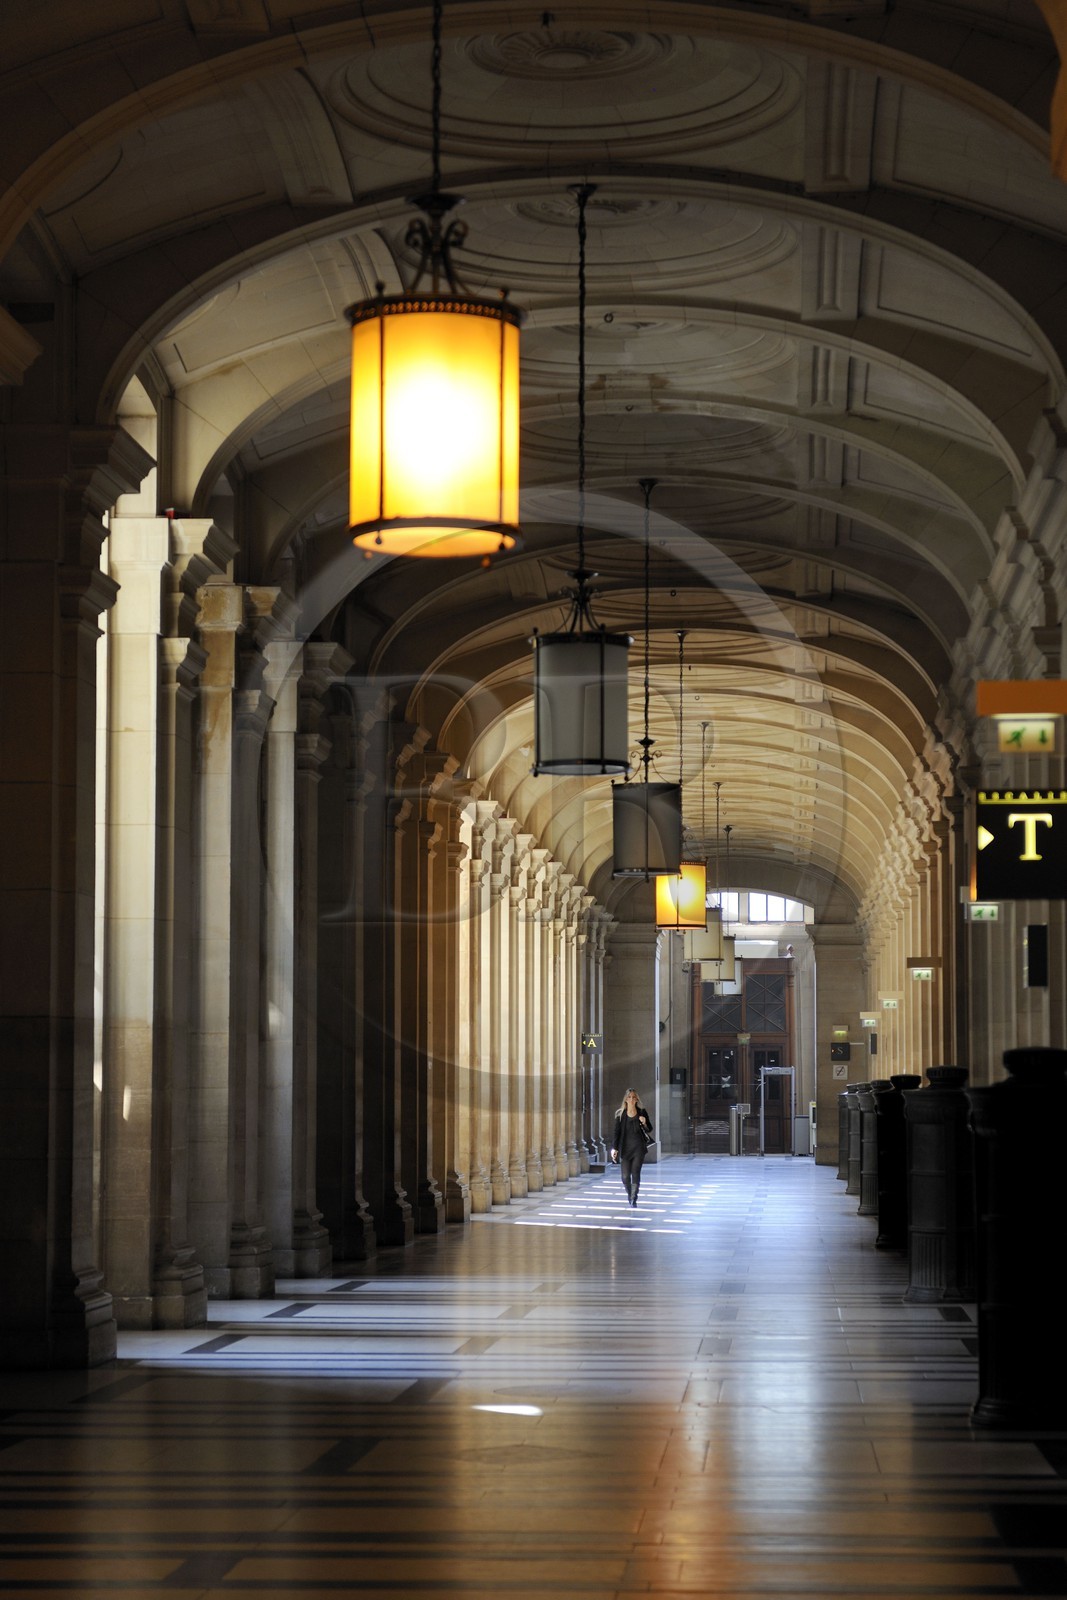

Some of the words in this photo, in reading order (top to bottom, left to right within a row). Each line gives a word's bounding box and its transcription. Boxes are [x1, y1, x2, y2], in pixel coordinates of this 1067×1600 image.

[1008, 813, 1053, 861] T
[587, 1037, 597, 1048] A
[837, 1047, 844, 1055] S
